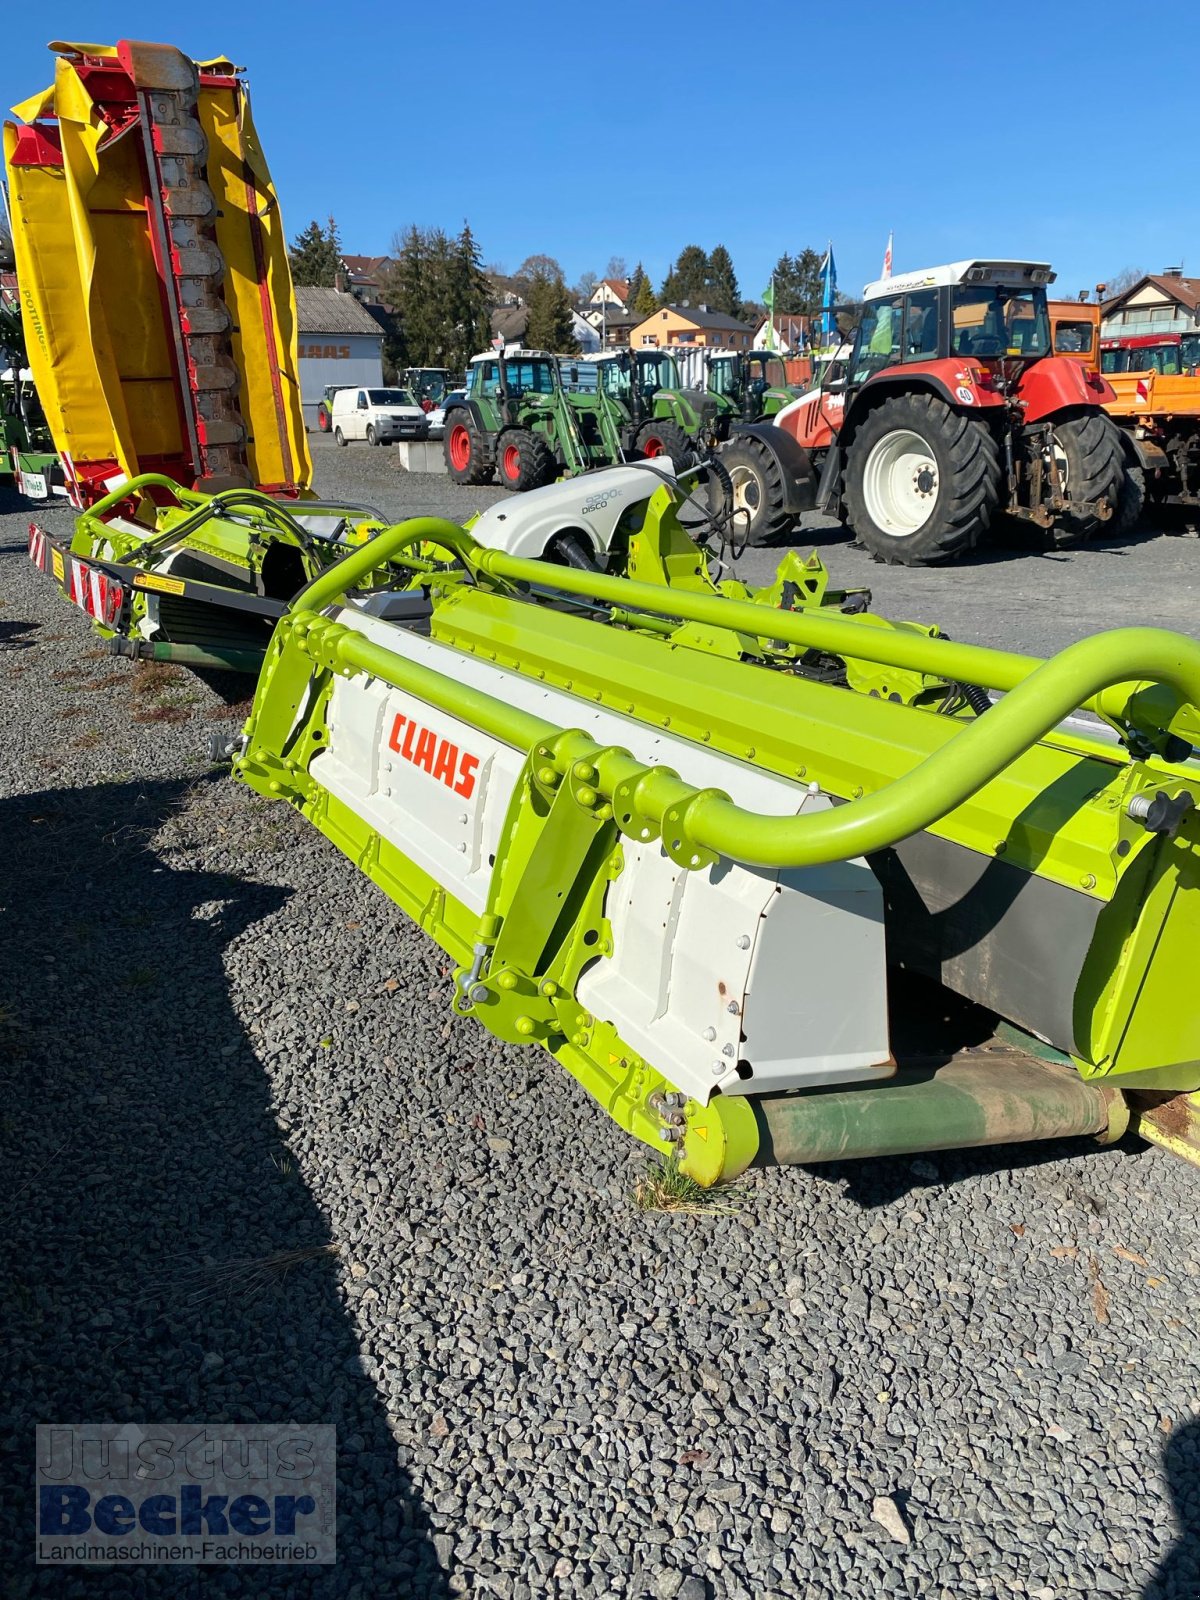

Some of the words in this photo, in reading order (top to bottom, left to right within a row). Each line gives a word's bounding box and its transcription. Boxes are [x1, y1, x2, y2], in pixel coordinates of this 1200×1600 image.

[959, 389, 972, 401] 40
[581, 500, 608, 515] DISCO
[389, 713, 479, 799] CLAAS
